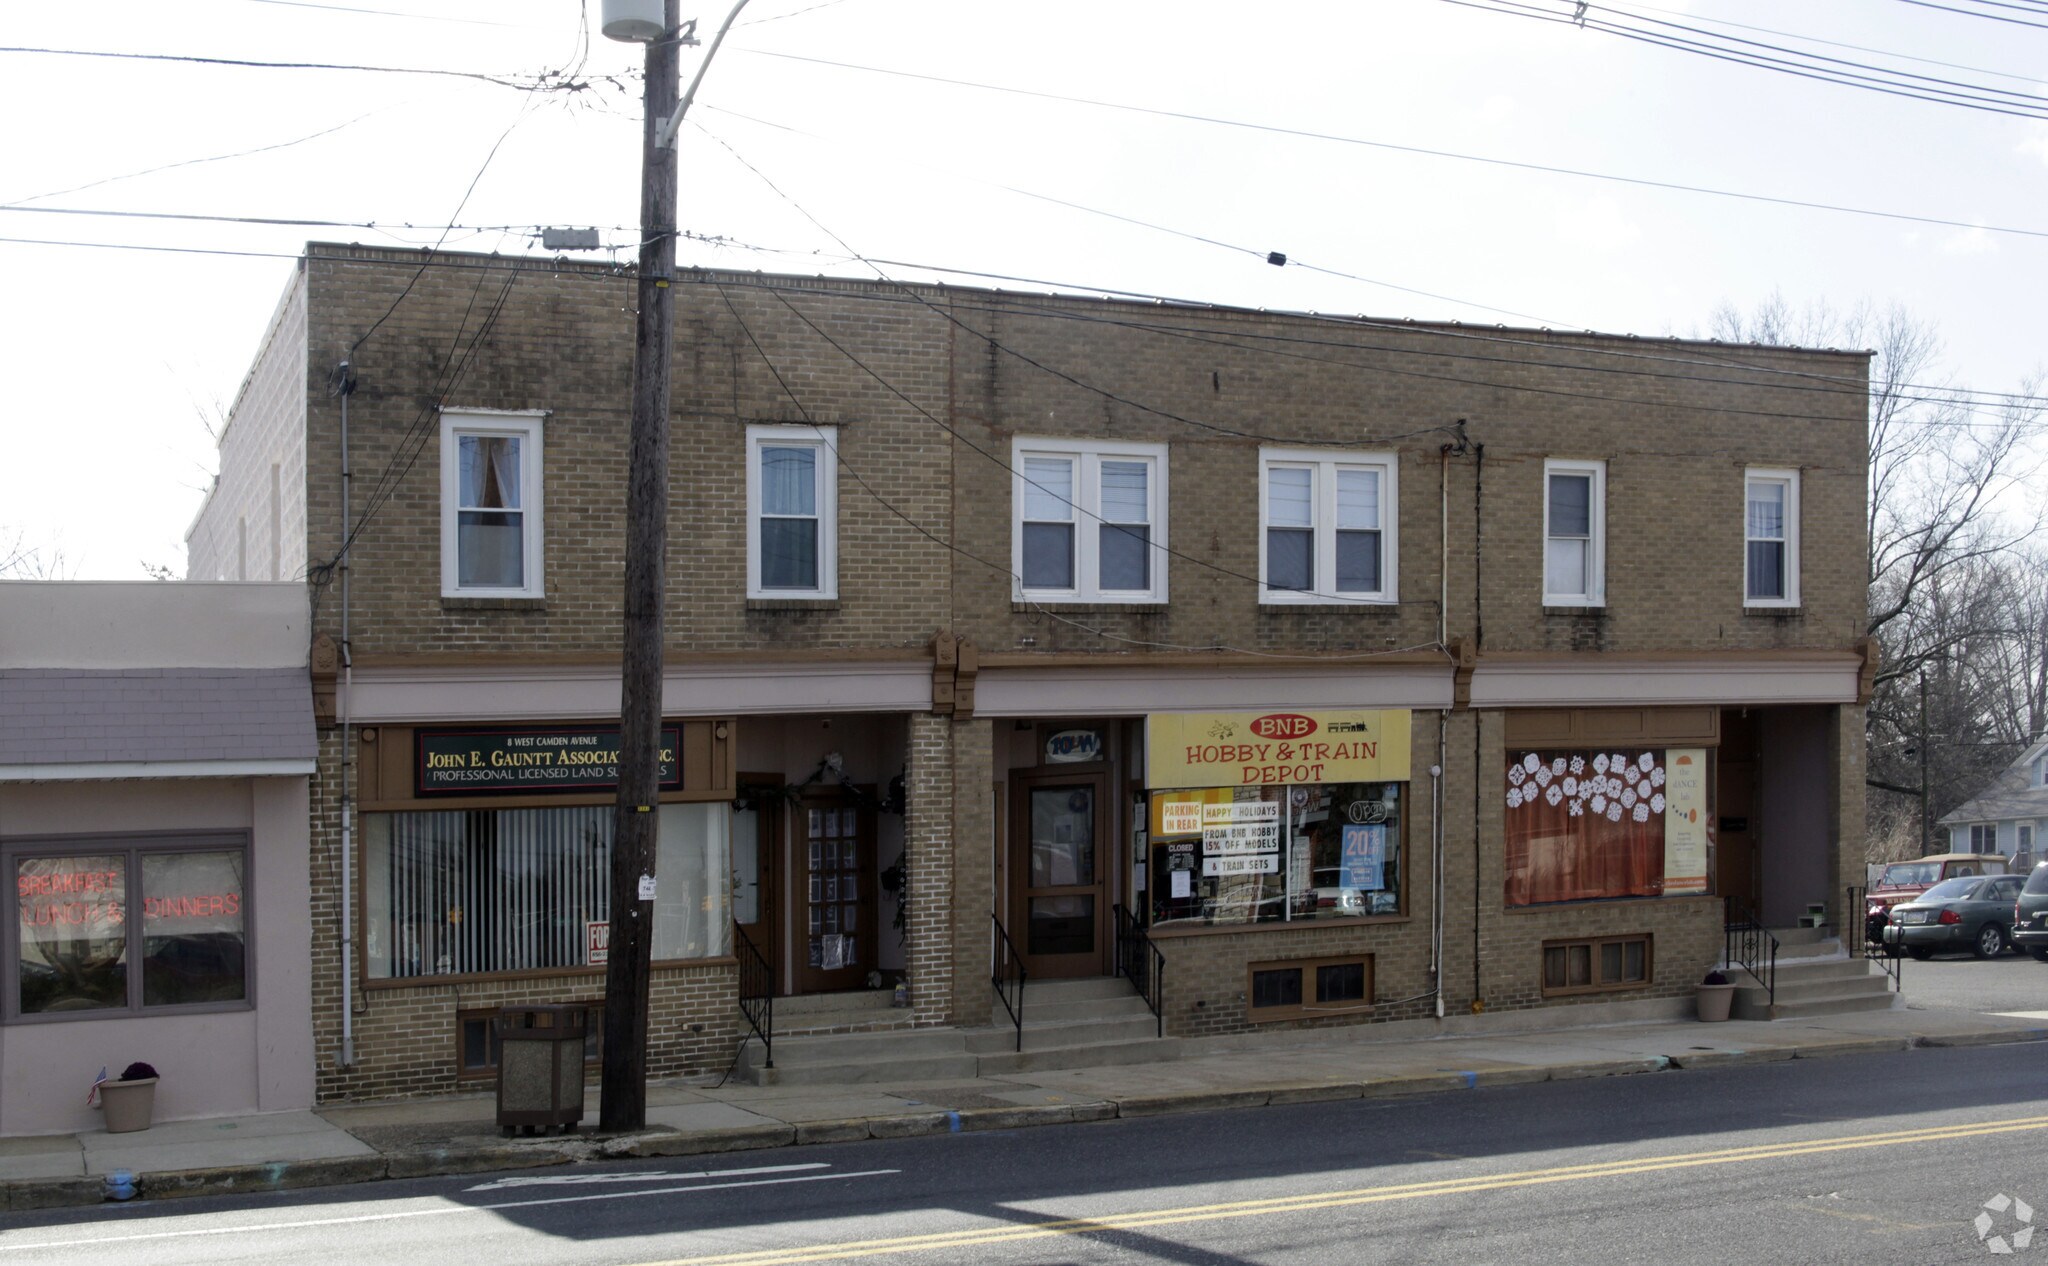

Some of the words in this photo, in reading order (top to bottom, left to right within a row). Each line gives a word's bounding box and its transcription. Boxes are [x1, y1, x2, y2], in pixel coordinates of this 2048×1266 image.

[1259, 718, 1309, 736] BNB
[507, 738, 512, 747] 8
[514, 738, 534, 747] WEST
[536, 737, 568, 746] CAMDEN
[570, 736, 598, 745] AVENUE
[427, 752, 465, 768] JOHN
[470, 751, 486, 767] E.
[491, 750, 553, 767] GAUNTT
[557, 749, 621, 765] ASSOCIA
[1186, 744, 1274, 765] HOBBY
[1275, 742, 1296, 760] &
[1299, 741, 1378, 761] TRAIN
[433, 769, 514, 781] PROFESSIONAL
[518, 768, 569, 779] LICENSED
[572, 767, 604, 778] LAND
[1242, 764, 1324, 784] DEPOT
[1679, 768, 1690, 776] the
[1164, 804, 1200, 817] PARKING
[1206, 807, 1232, 818] HAPPY
[1239, 806, 1276, 816] HOLIDAYS
[1352, 802, 1384, 821] Open
[1166, 819, 1175, 831] IN
[1176, 818, 1198, 830] REAR
[1204, 829, 1227, 840] FROM
[1231, 828, 1247, 838] BNB
[1251, 826, 1277, 837] HOBBY
[1168, 843, 1194, 852] CLOSED
[1205, 841, 1220, 851] 15%
[1225, 840, 1240, 850] OFF
[1244, 838, 1277, 849] MODELS
[1212, 861, 1217, 871] &
[1222, 861, 1245, 871] TRAIN
[1249, 859, 1269, 870] SETS
[18, 871, 117, 897] BREAKFAST
[143, 892, 239, 918] DINNERS
[23, 902, 100, 926] LUNCH
[106, 900, 123, 923] &
